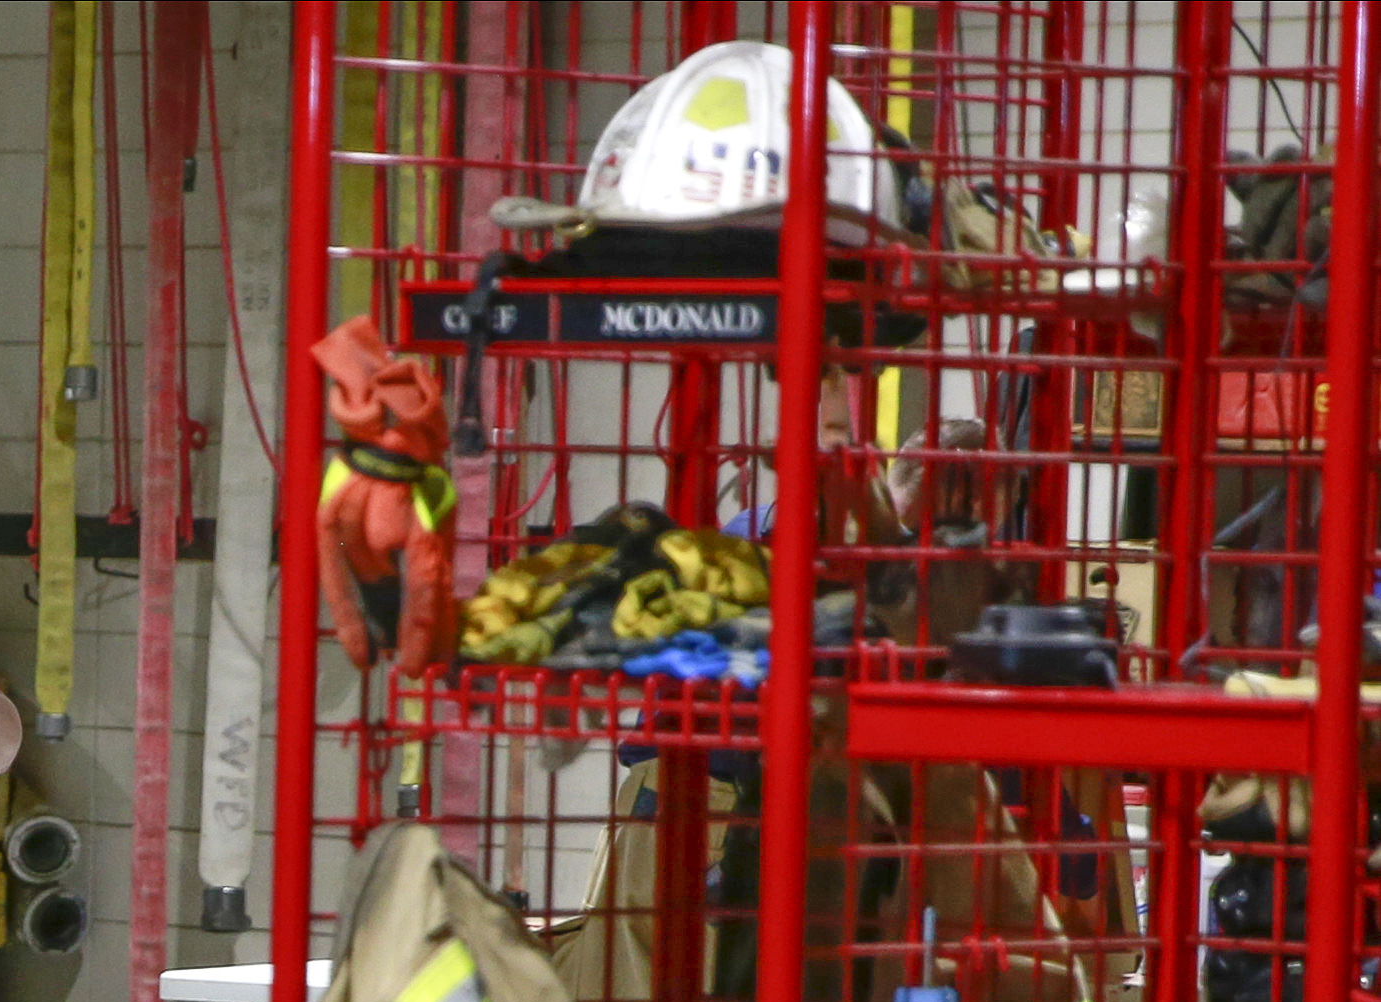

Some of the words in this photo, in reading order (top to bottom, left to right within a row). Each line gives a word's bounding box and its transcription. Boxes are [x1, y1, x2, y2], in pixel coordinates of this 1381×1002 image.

[442, 304, 519, 334] CHF
[600, 303, 767, 336] MCDONALD
[214, 716, 255, 831] WFD
